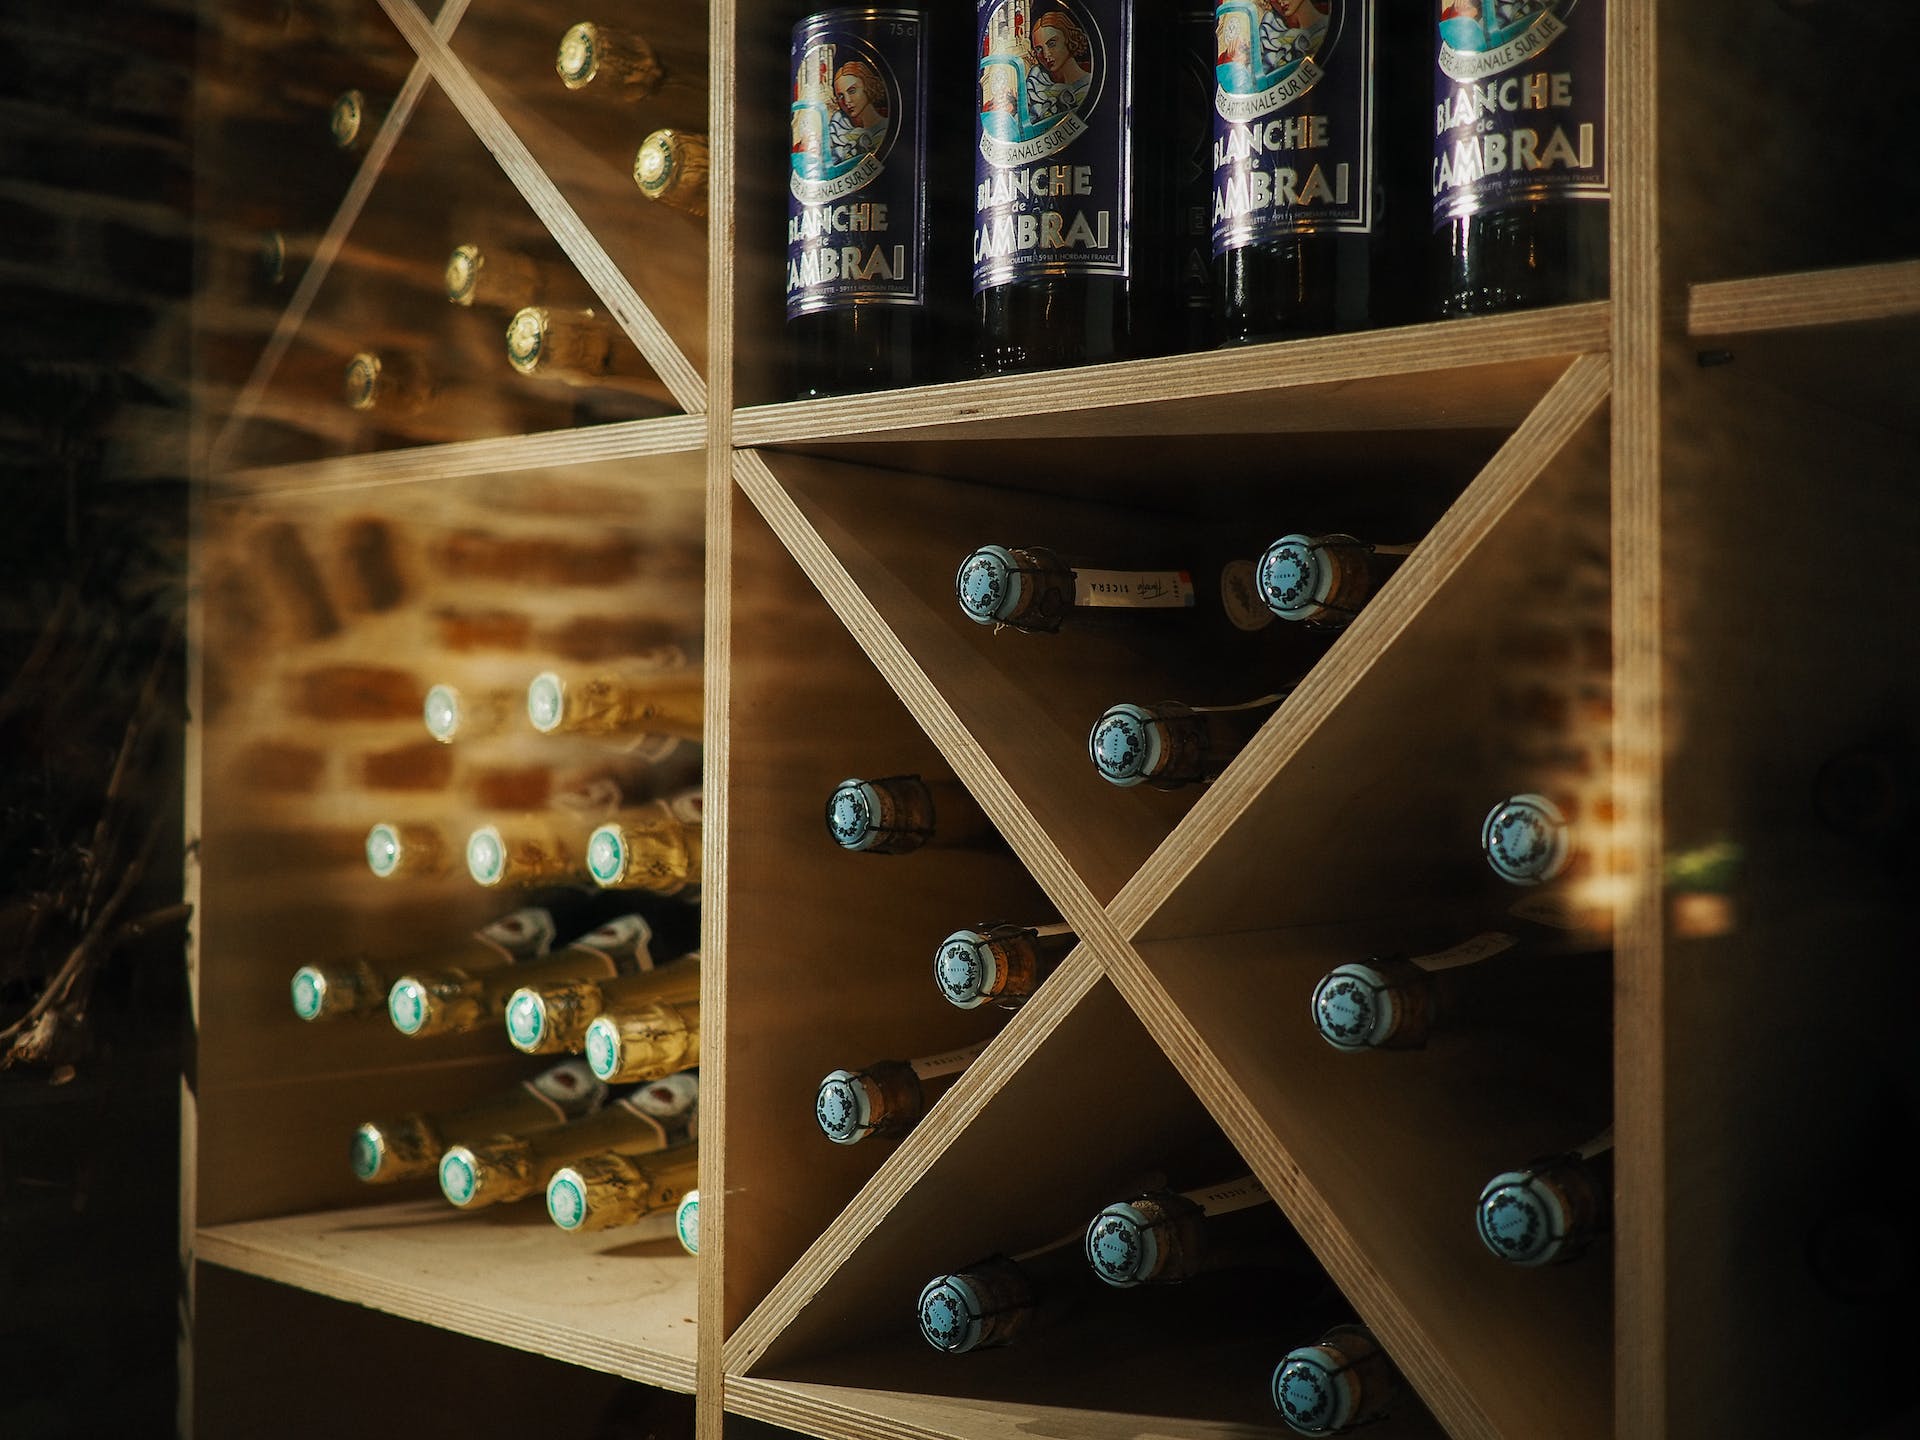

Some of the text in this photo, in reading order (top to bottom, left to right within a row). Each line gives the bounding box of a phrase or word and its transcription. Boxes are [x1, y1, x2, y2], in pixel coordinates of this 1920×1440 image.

[1514, 32, 1540, 56] SUR
[1537, 18, 1558, 40] LIE
[1278, 79, 1301, 100] SUR
[1298, 65, 1317, 83] LIE
[1436, 71, 1572, 136] BLANCHE
[1044, 131, 1065, 149] SUR
[1064, 118, 1081, 135] LIE
[1476, 119, 1494, 133] de
[1213, 115, 1330, 171] BLANCHE
[844, 171, 864, 188] SUR
[862, 159, 878, 177] LIE
[1245, 159, 1260, 170] de
[976, 165, 1092, 211] BLANCHE
[1212, 163, 1349, 227] AMBRAI
[1011, 200, 1026, 212] de
[788, 203, 888, 245] BLANCHE
[816, 236, 829, 247] de
[1090, 253, 1115, 261] FRANCE
[1090, 583, 1129, 593] SICERA
